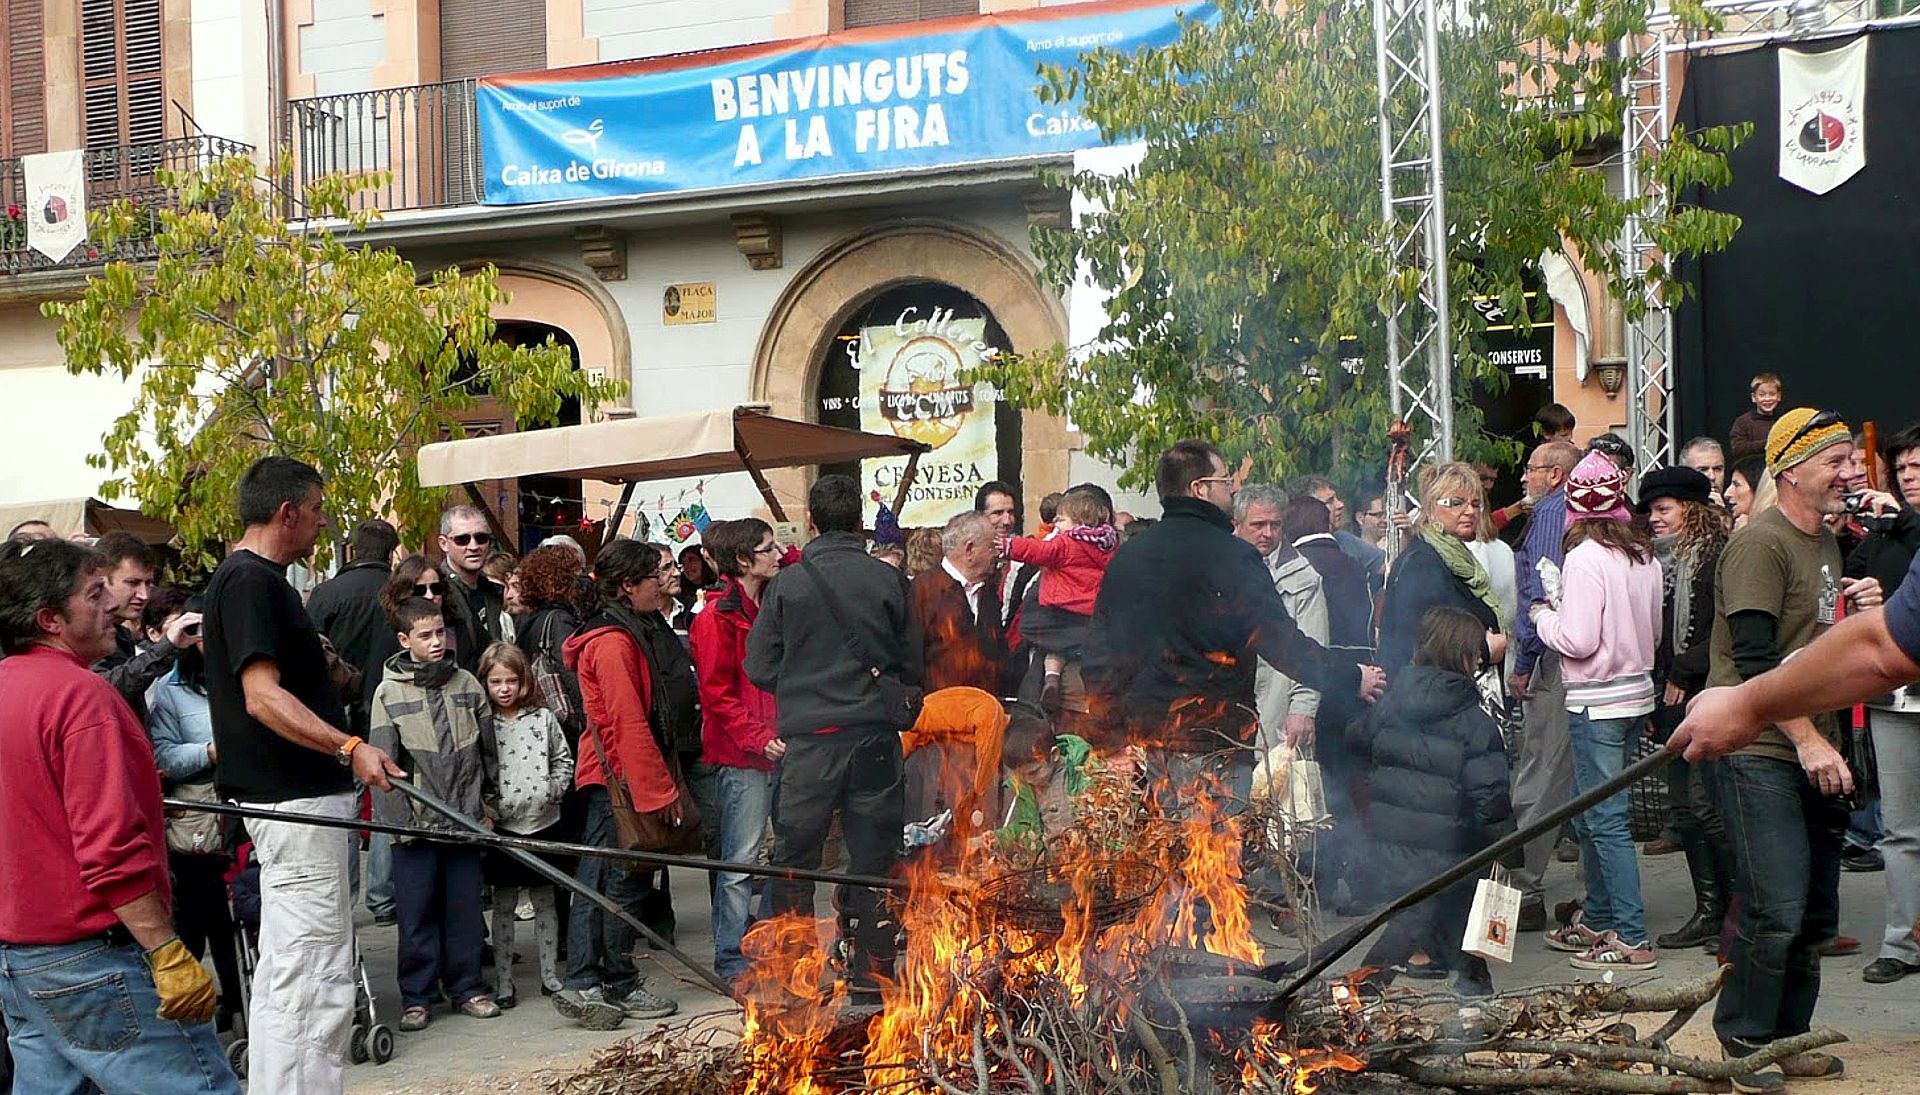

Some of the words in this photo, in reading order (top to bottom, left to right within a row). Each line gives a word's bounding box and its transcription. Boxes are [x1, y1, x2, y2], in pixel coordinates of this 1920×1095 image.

[1026, 39, 1052, 52] Amb
[1054, 36, 1065, 48] el
[1067, 33, 1104, 47] suport
[1106, 31, 1124, 42] de
[711, 50, 969, 122] BENVINGUTS
[528, 99, 537, 111] el
[538, 97, 567, 112] suport
[568, 95, 581, 107] de
[733, 124, 762, 167] A
[784, 115, 833, 160] LA
[855, 103, 950, 153] FIRA
[1027, 110, 1098, 137] Caixa
[501, 164, 562, 186] Caixa
[565, 160, 590, 182] de
[592, 158, 666, 180] Girona
[681, 309, 715, 320] MAJOR
[1488, 348, 1542, 365] CONSERVES
[874, 461, 985, 487] CERVESA
